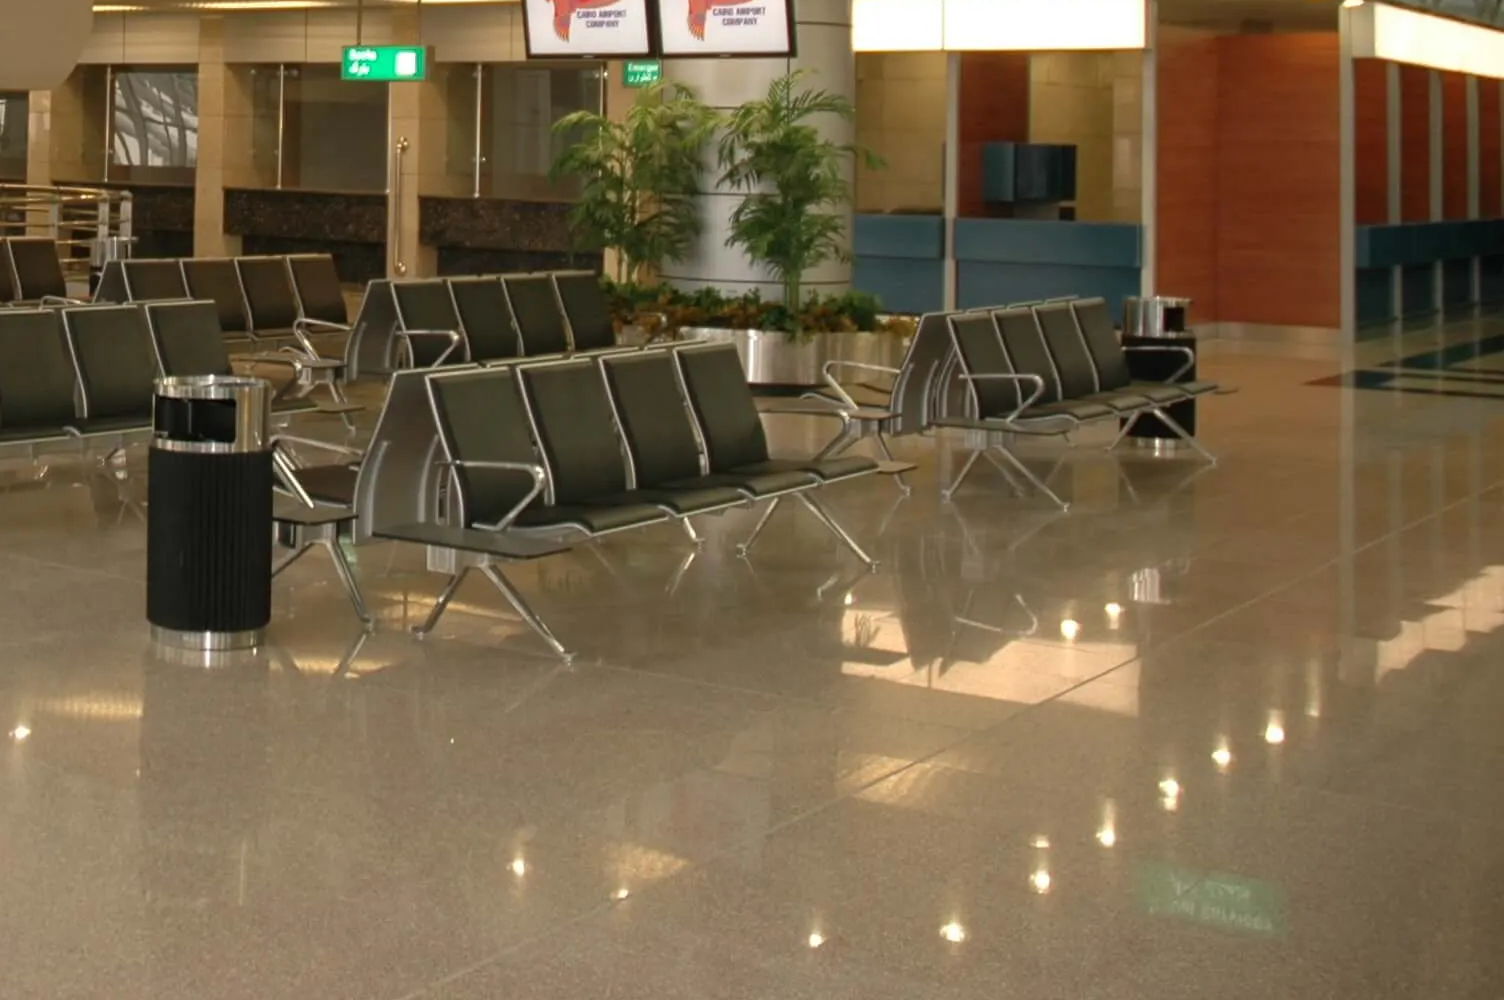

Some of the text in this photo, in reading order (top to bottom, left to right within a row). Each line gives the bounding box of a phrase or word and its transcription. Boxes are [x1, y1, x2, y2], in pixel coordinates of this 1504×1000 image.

[577, 9, 626, 19] CAIRO AIRPORT
[712, 6, 766, 16] CAIRO AIRPORT
[586, 20, 620, 28] COMPANY
[722, 17, 758, 26] COMPANY
